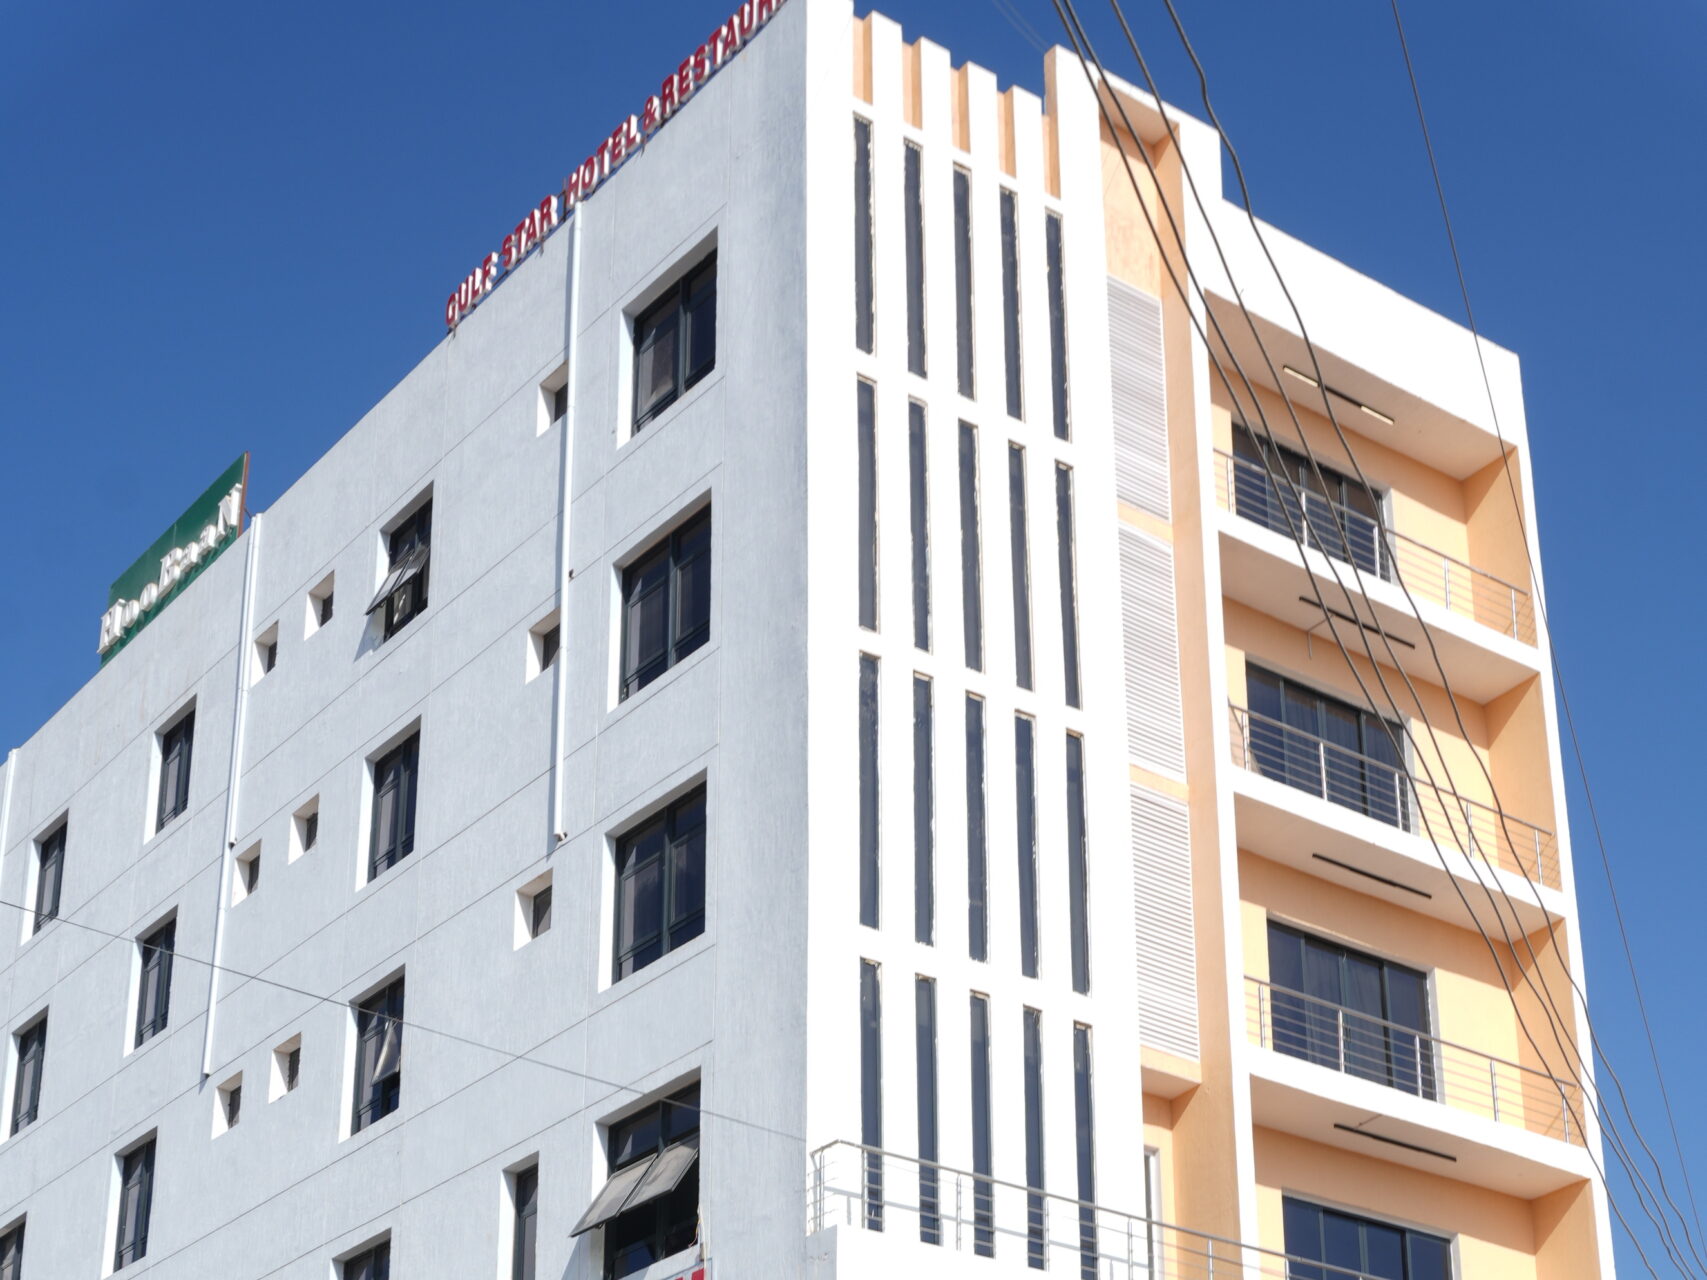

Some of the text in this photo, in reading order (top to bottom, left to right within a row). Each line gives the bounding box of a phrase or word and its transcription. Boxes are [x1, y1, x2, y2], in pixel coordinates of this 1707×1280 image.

[446, 251, 498, 327] GULF
[502, 194, 558, 271] STAR
[567, 113, 641, 208] HOTEL
[642, 95, 660, 133] &
